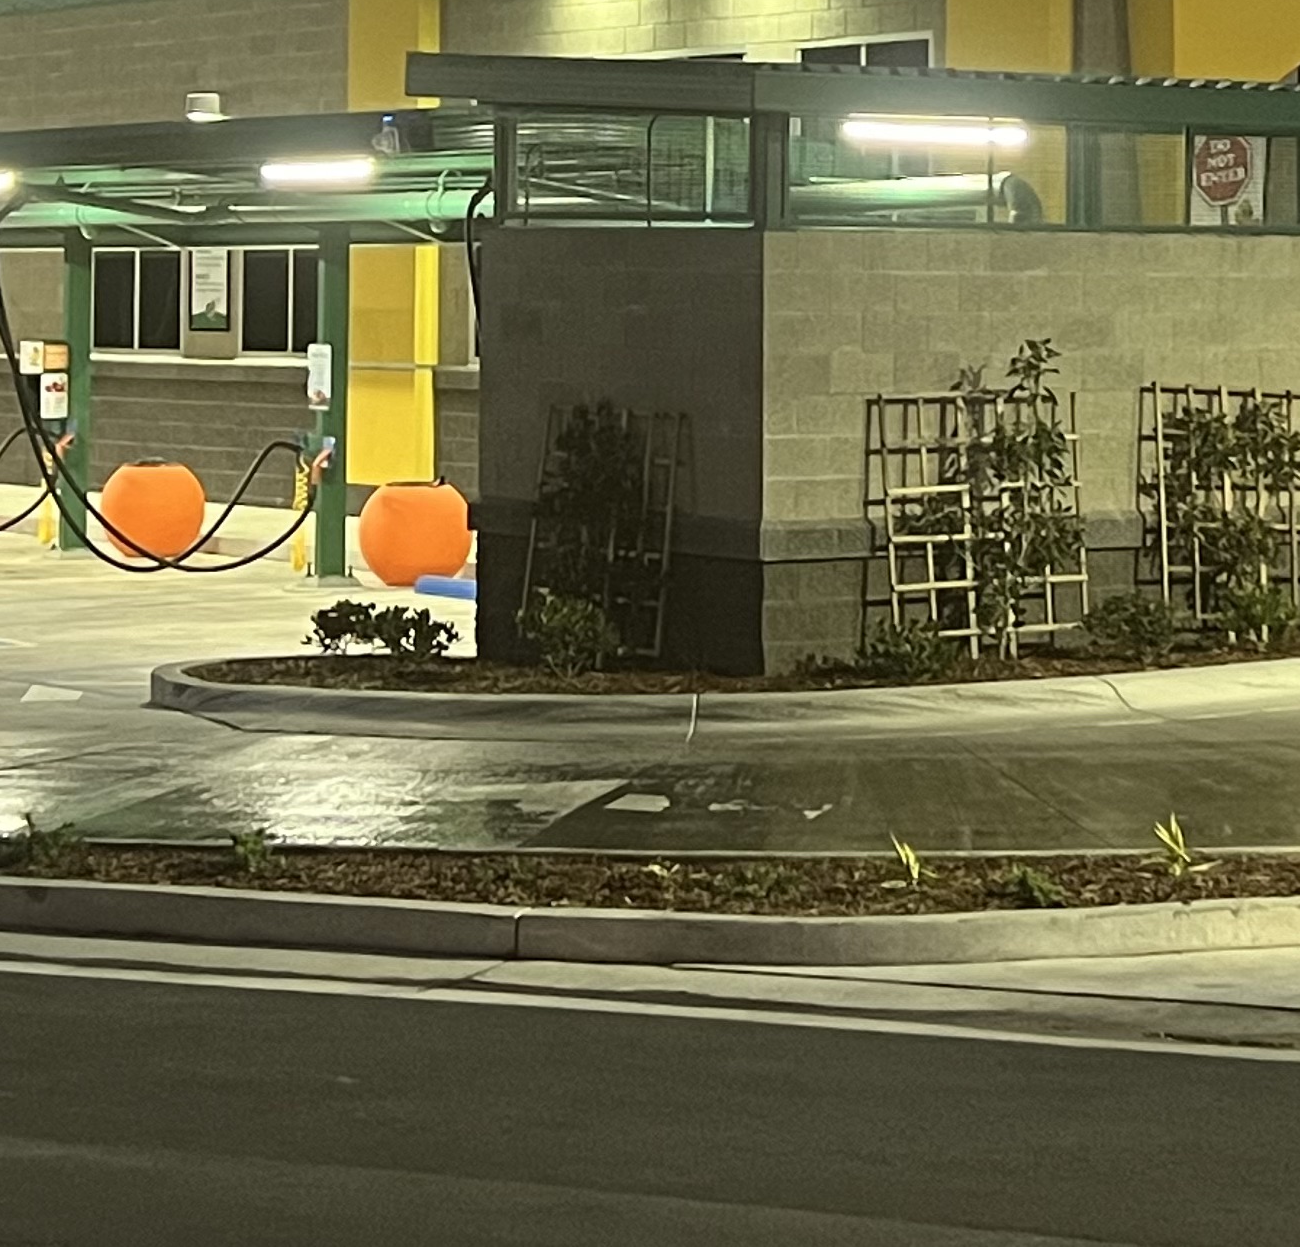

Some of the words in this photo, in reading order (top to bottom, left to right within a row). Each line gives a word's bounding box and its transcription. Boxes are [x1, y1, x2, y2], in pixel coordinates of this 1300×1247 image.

[1209, 139, 1231, 153] DO
[1207, 153, 1236, 168] NOT
[1200, 166, 1245, 187] ENTER
